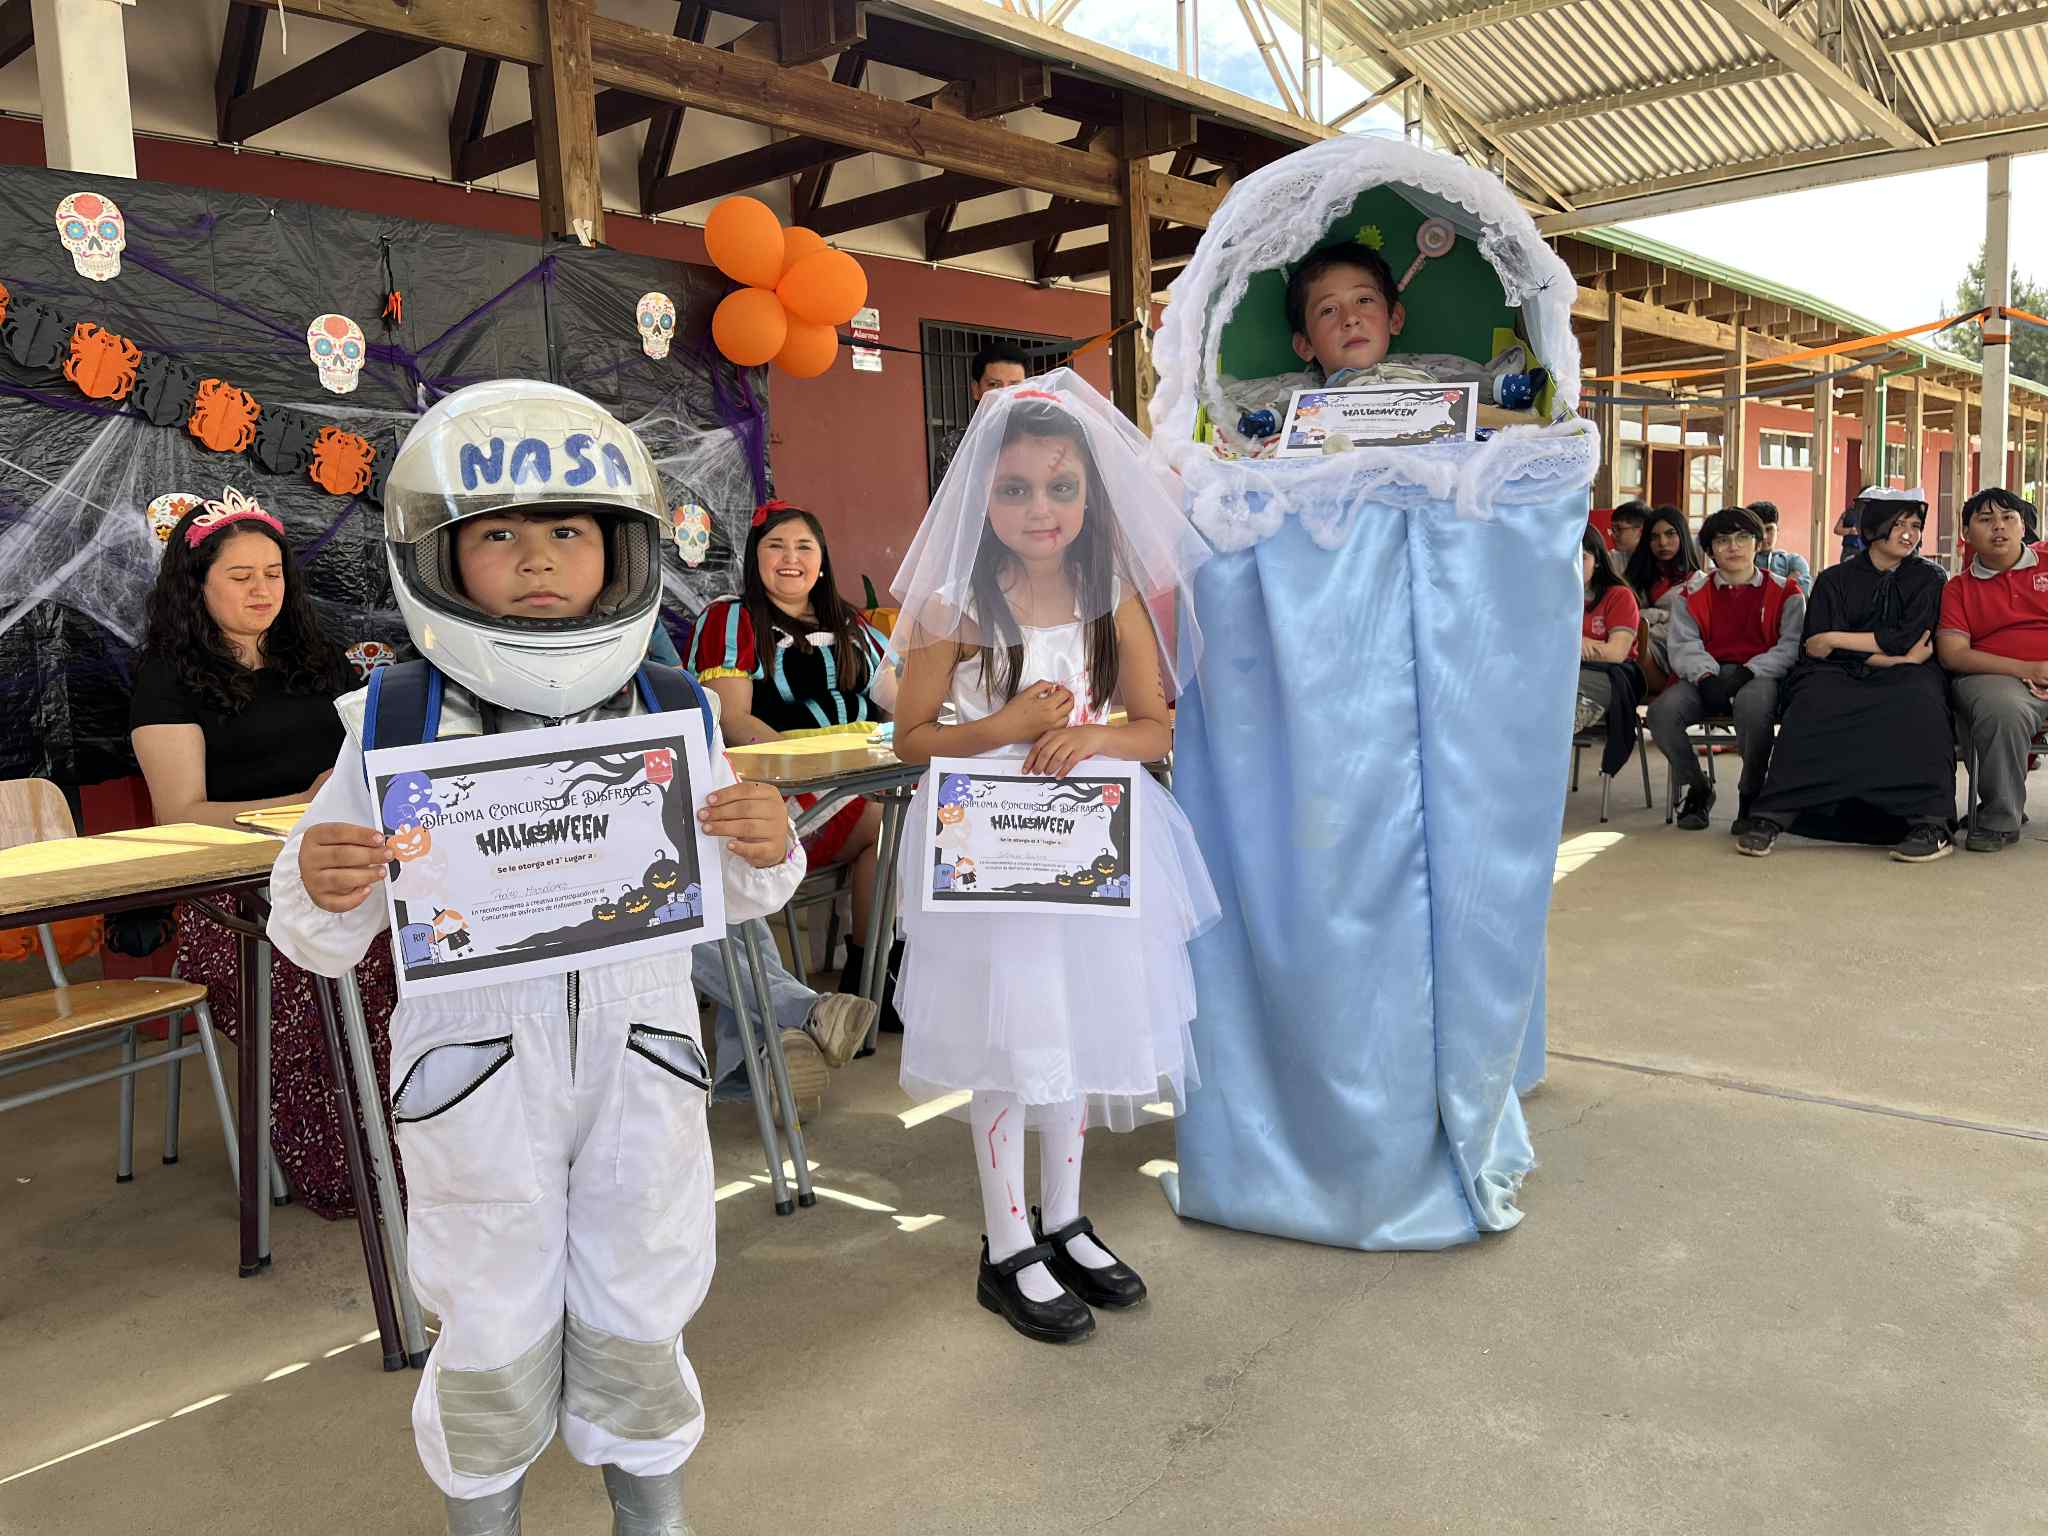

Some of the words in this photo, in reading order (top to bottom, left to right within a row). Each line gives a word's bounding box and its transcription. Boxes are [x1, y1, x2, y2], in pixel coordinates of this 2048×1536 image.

[459, 433, 632, 491] NASA
[475, 813, 609, 856] HALLOWEEN
[990, 814, 1075, 834] HALLOWEEN
[497, 866, 507, 874] Se
[508, 864, 516, 872] le
[518, 860, 545, 871] otorga
[546, 858, 554, 866] el
[564, 854, 586, 865] Lugar
